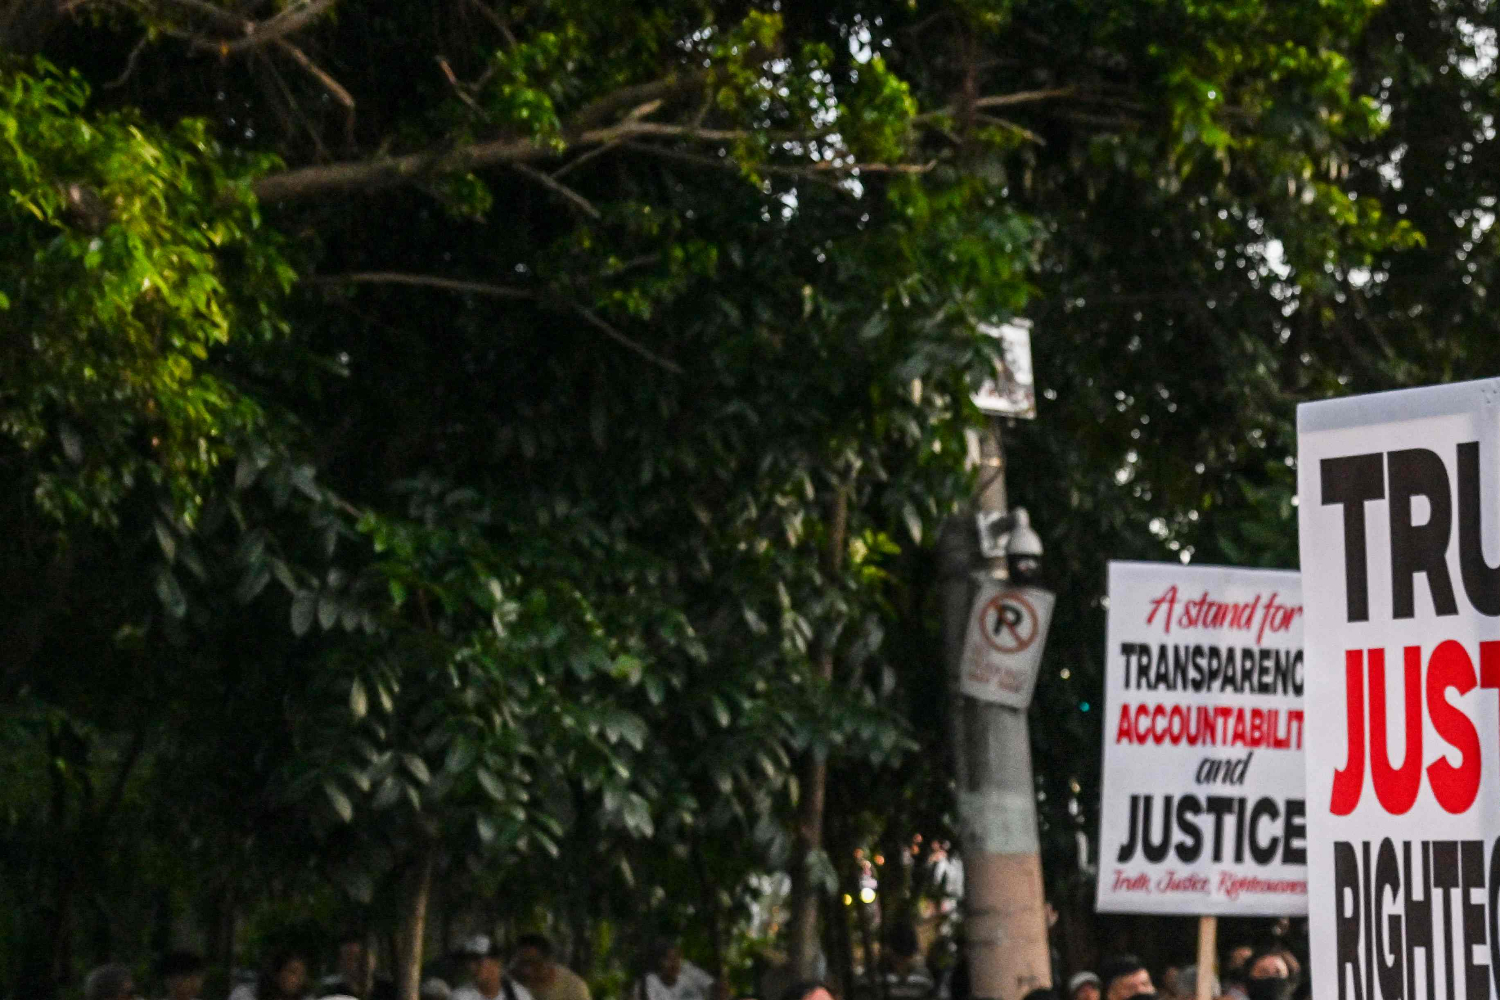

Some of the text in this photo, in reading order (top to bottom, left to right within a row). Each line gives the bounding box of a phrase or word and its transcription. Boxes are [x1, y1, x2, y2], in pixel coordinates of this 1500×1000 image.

[1146, 583, 1304, 646] A stand for
[1121, 642, 1304, 696] TRANSPARENC
[1116, 702, 1304, 750] ACCOUNTABILIT
[1194, 751, 1253, 786] and
[1117, 793, 1307, 866] JUSTICE
